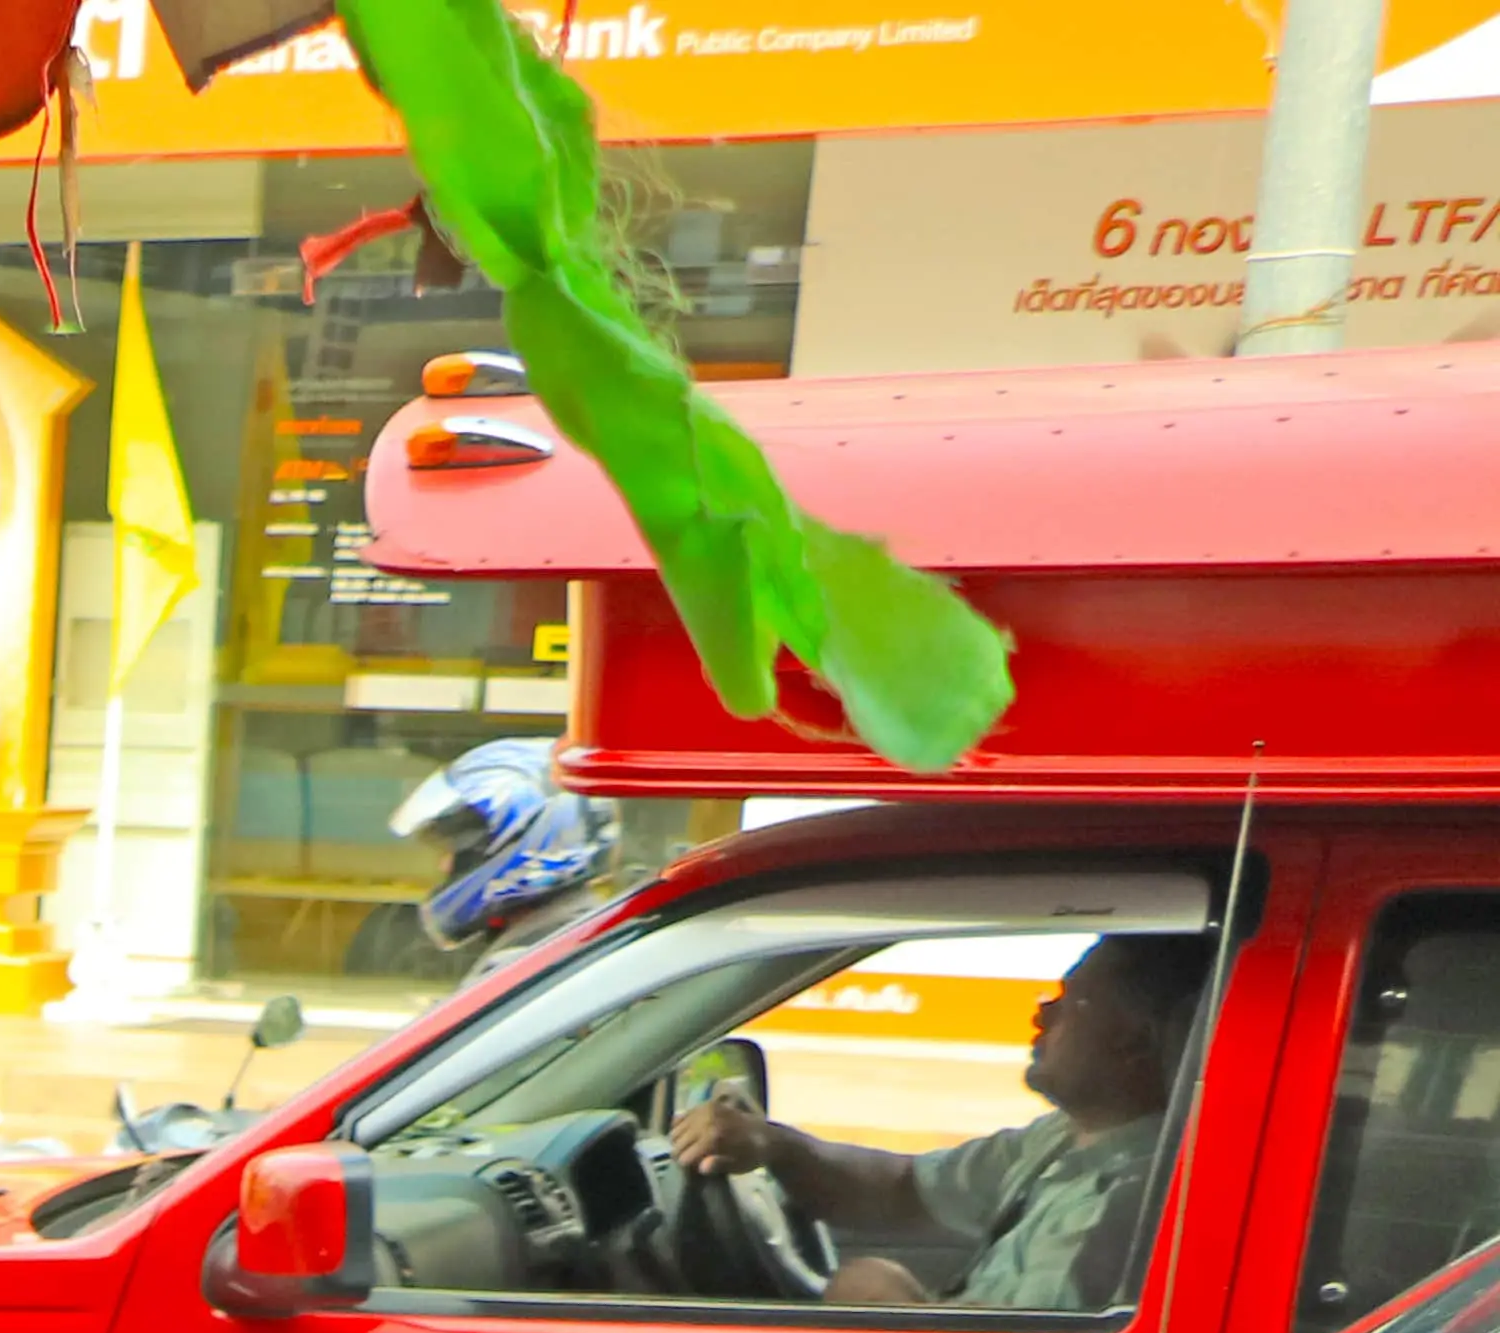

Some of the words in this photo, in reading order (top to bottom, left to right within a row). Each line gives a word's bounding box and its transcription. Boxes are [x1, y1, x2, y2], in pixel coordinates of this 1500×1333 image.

[757, 26, 872, 52] Company
[1093, 198, 1143, 258] 6
[1362, 197, 1500, 247] LTF/
